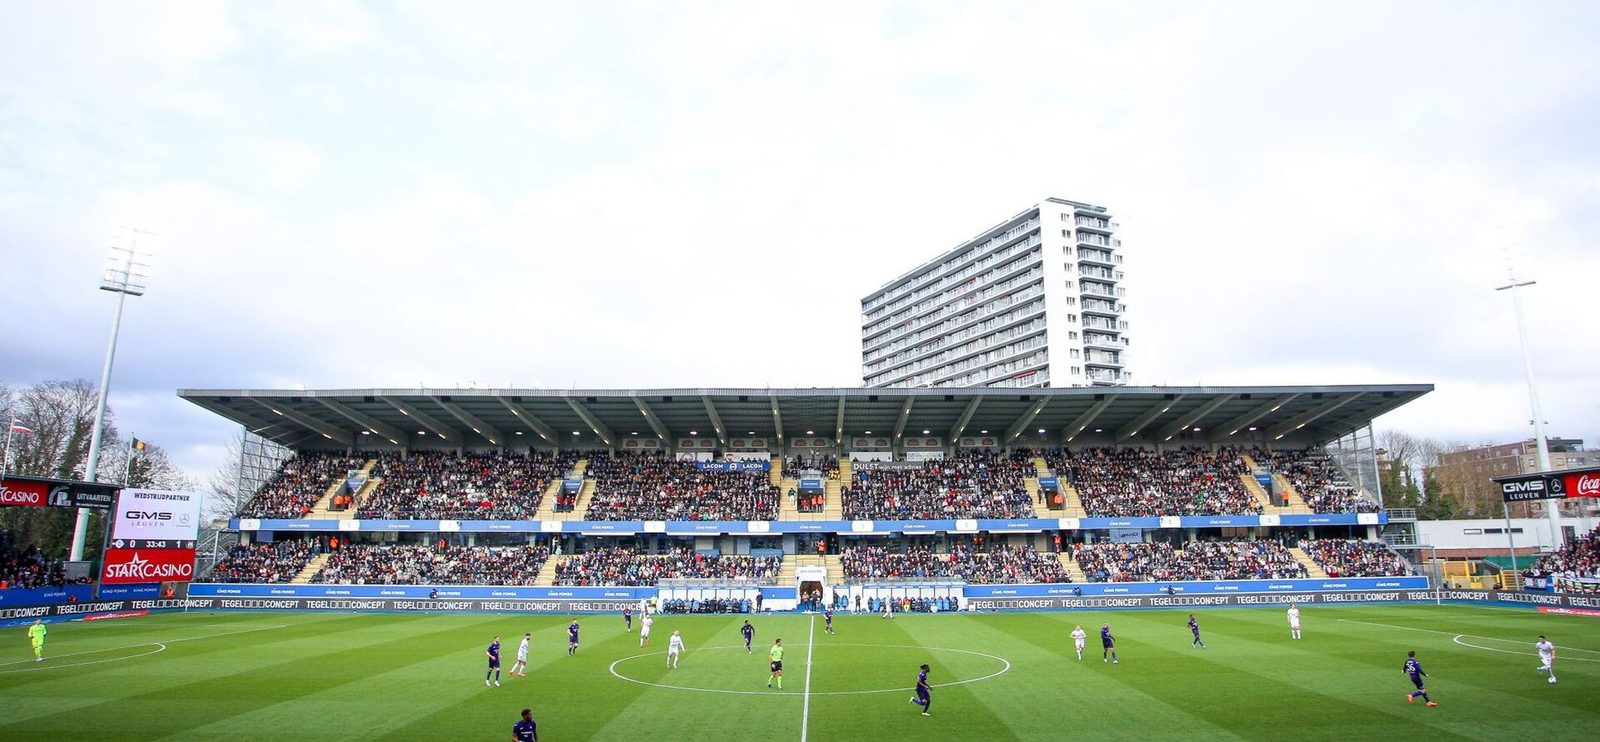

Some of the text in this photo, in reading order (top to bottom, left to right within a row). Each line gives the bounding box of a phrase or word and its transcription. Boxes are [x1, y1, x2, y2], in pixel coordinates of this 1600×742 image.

[1503, 481, 1544, 492] GMS
[4, 491, 39, 502] CASINO
[77, 493, 111, 502] UITVAARTEN
[126, 511, 172, 520] GMS
[1452, 591, 1489, 600] CONCEPT
[1497, 593, 1562, 604] TEGEL CONCEPT
[180, 600, 213, 608] CONCEPT
[1018, 600, 1054, 608] CONCEPT
[1568, 597, 1591, 606] TEGEL
[16, 607, 50, 617] CONCEPT
[57, 602, 124, 614] TEGEL CONCEPT
